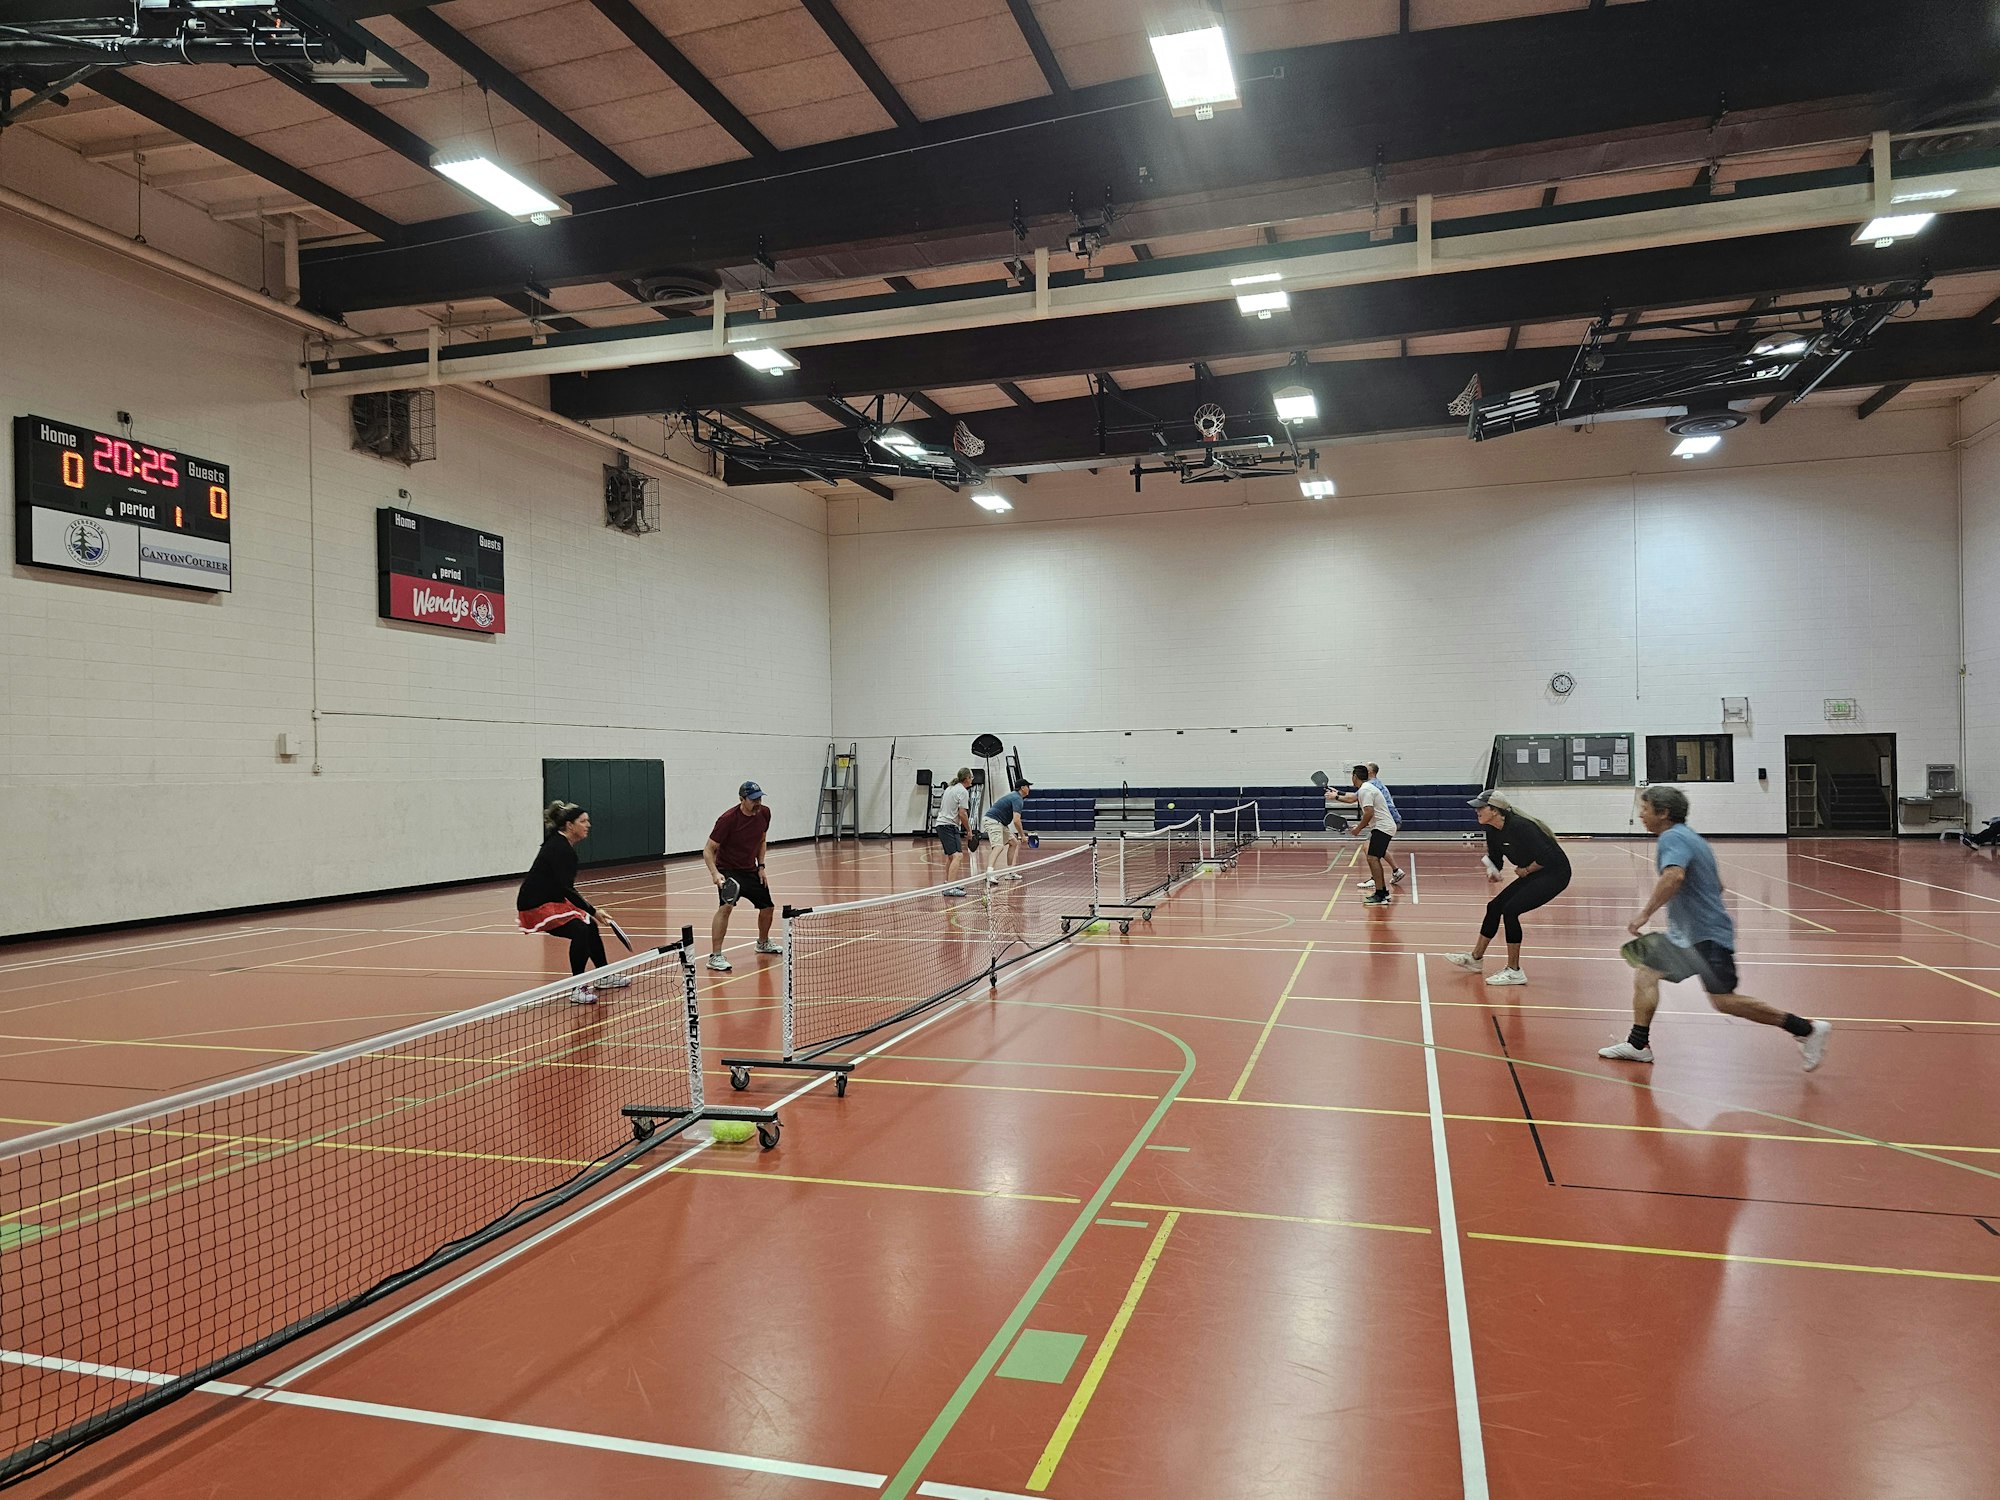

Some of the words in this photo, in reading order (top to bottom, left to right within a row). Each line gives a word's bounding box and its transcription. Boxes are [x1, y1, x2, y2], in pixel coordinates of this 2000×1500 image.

[40, 423, 77, 448] Home
[62, 450, 84, 489] 0
[93, 435, 180, 488] 20:25
[188, 462, 225, 484] Guests
[119, 501, 156, 520] period
[209, 486, 228, 519] 0
[175, 505, 183, 528] 1
[395, 513, 416, 530] Home
[479, 535, 501, 551] Guests
[440, 567, 461, 580] period
[413, 587, 469, 622] Wendy's
[690, 1041, 699, 1075] Deluxe
